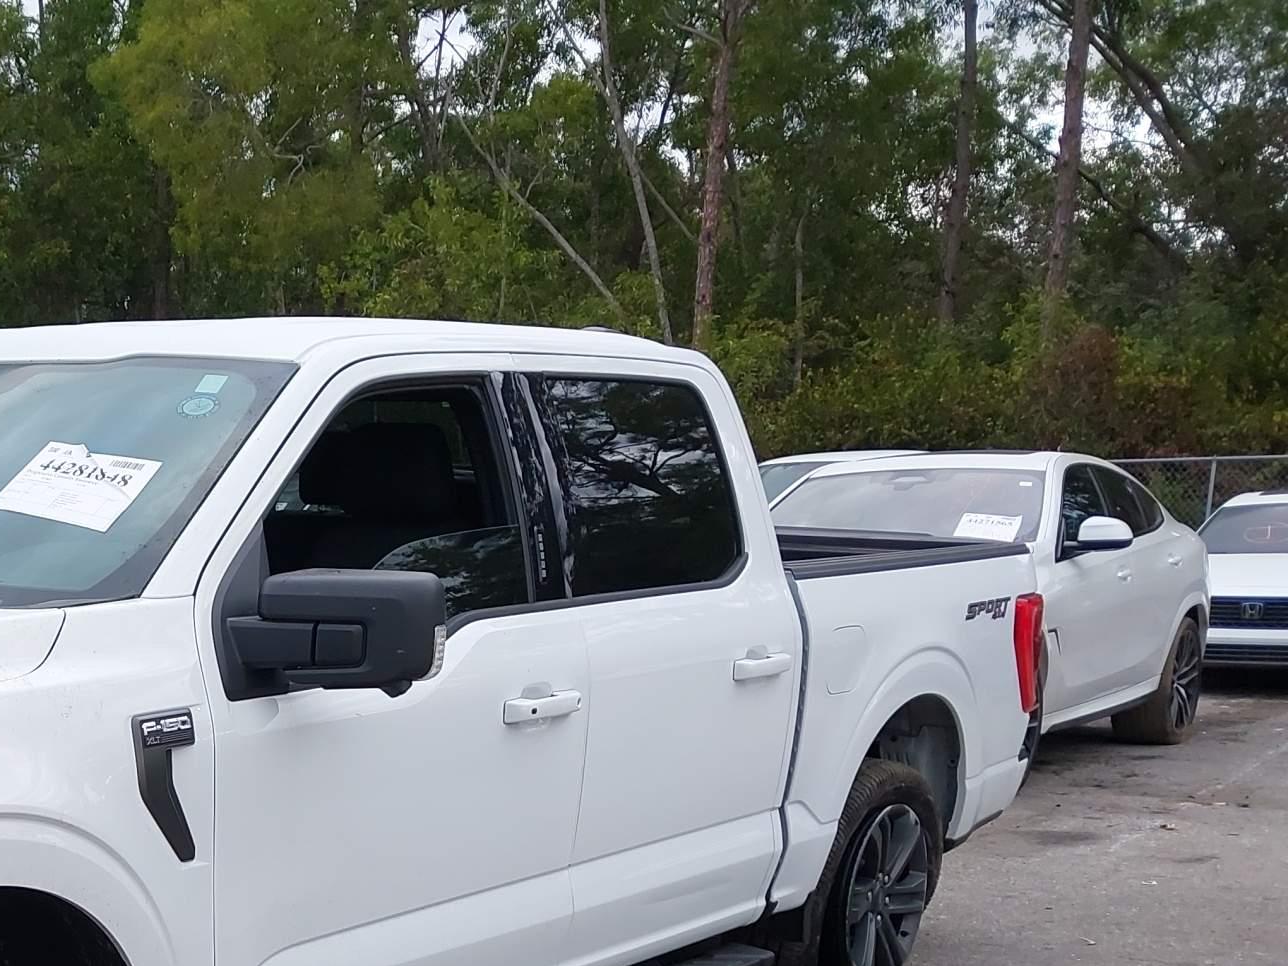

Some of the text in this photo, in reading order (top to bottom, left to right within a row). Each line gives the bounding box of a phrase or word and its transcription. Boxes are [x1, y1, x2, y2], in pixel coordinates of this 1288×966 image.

[40, 458, 133, 487] 44281848
[965, 595, 1012, 621] SPORT
[141, 715, 192, 736] F-150
